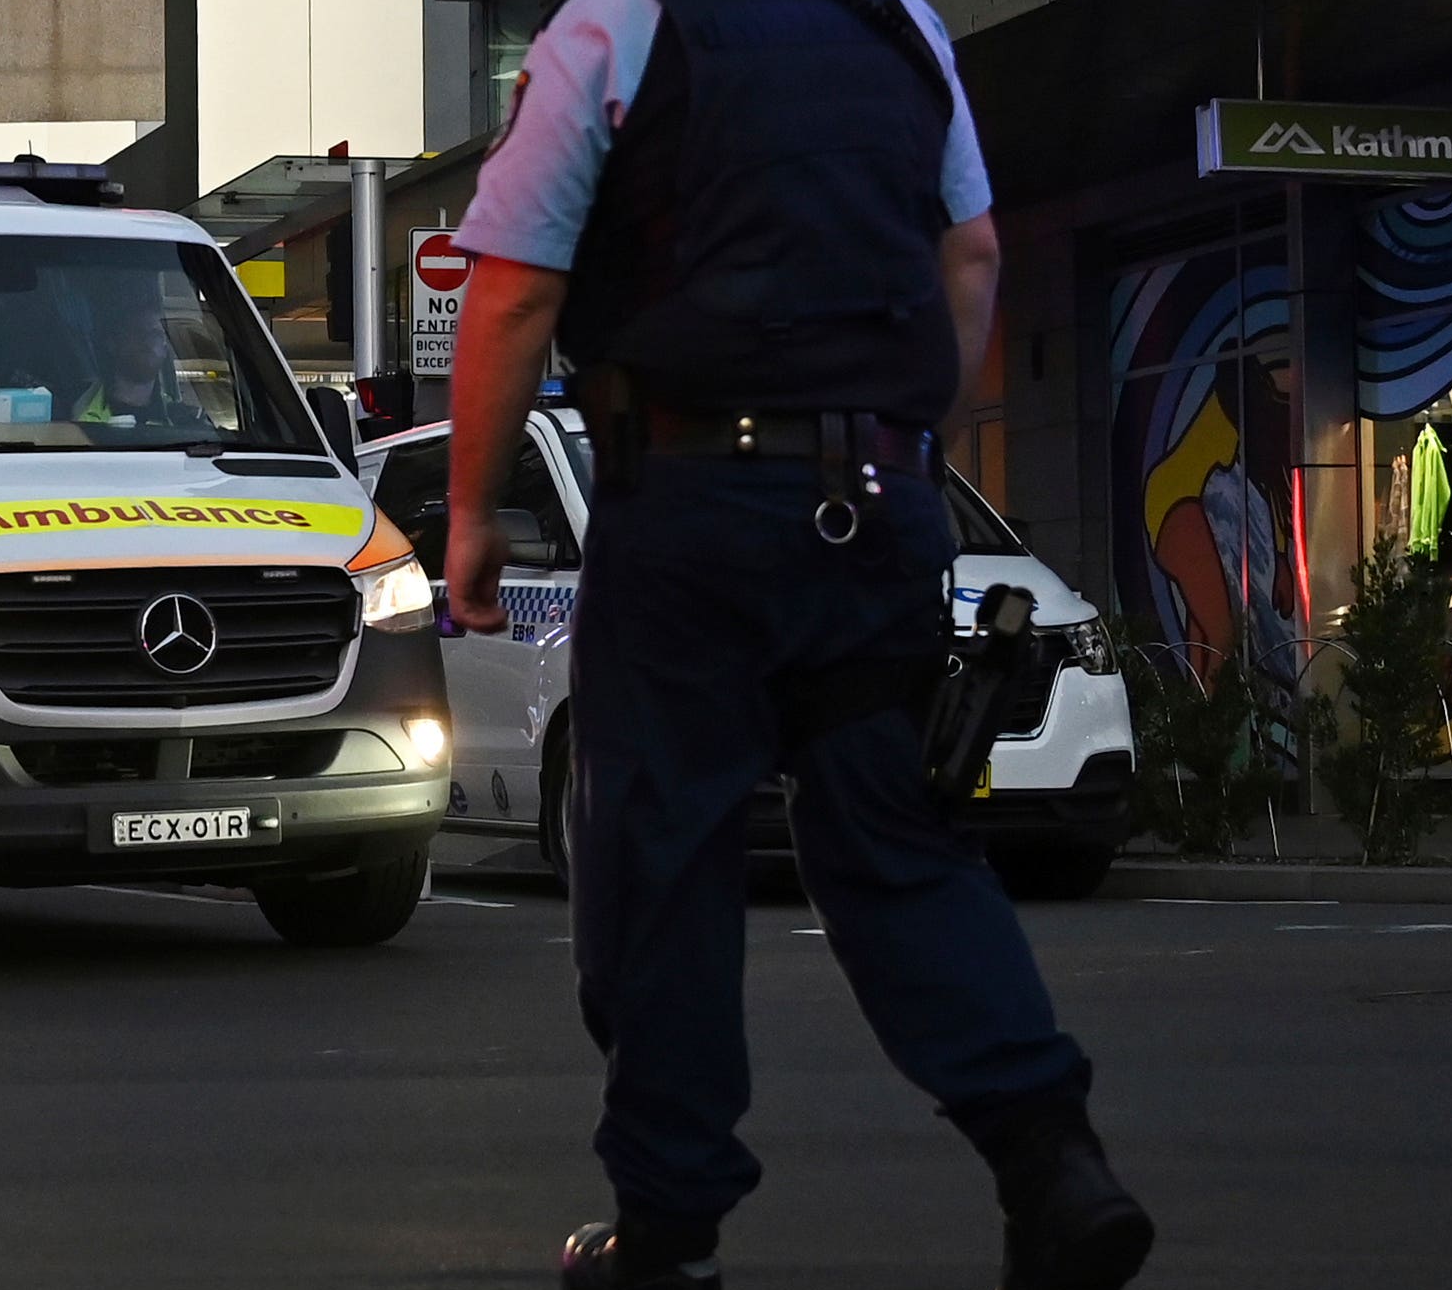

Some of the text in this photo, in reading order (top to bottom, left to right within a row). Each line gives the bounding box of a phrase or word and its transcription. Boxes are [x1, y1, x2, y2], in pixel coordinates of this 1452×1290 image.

[428, 297, 458, 315] NO
[416, 319, 459, 333] ENTR
[415, 357, 452, 368] EXCEP
